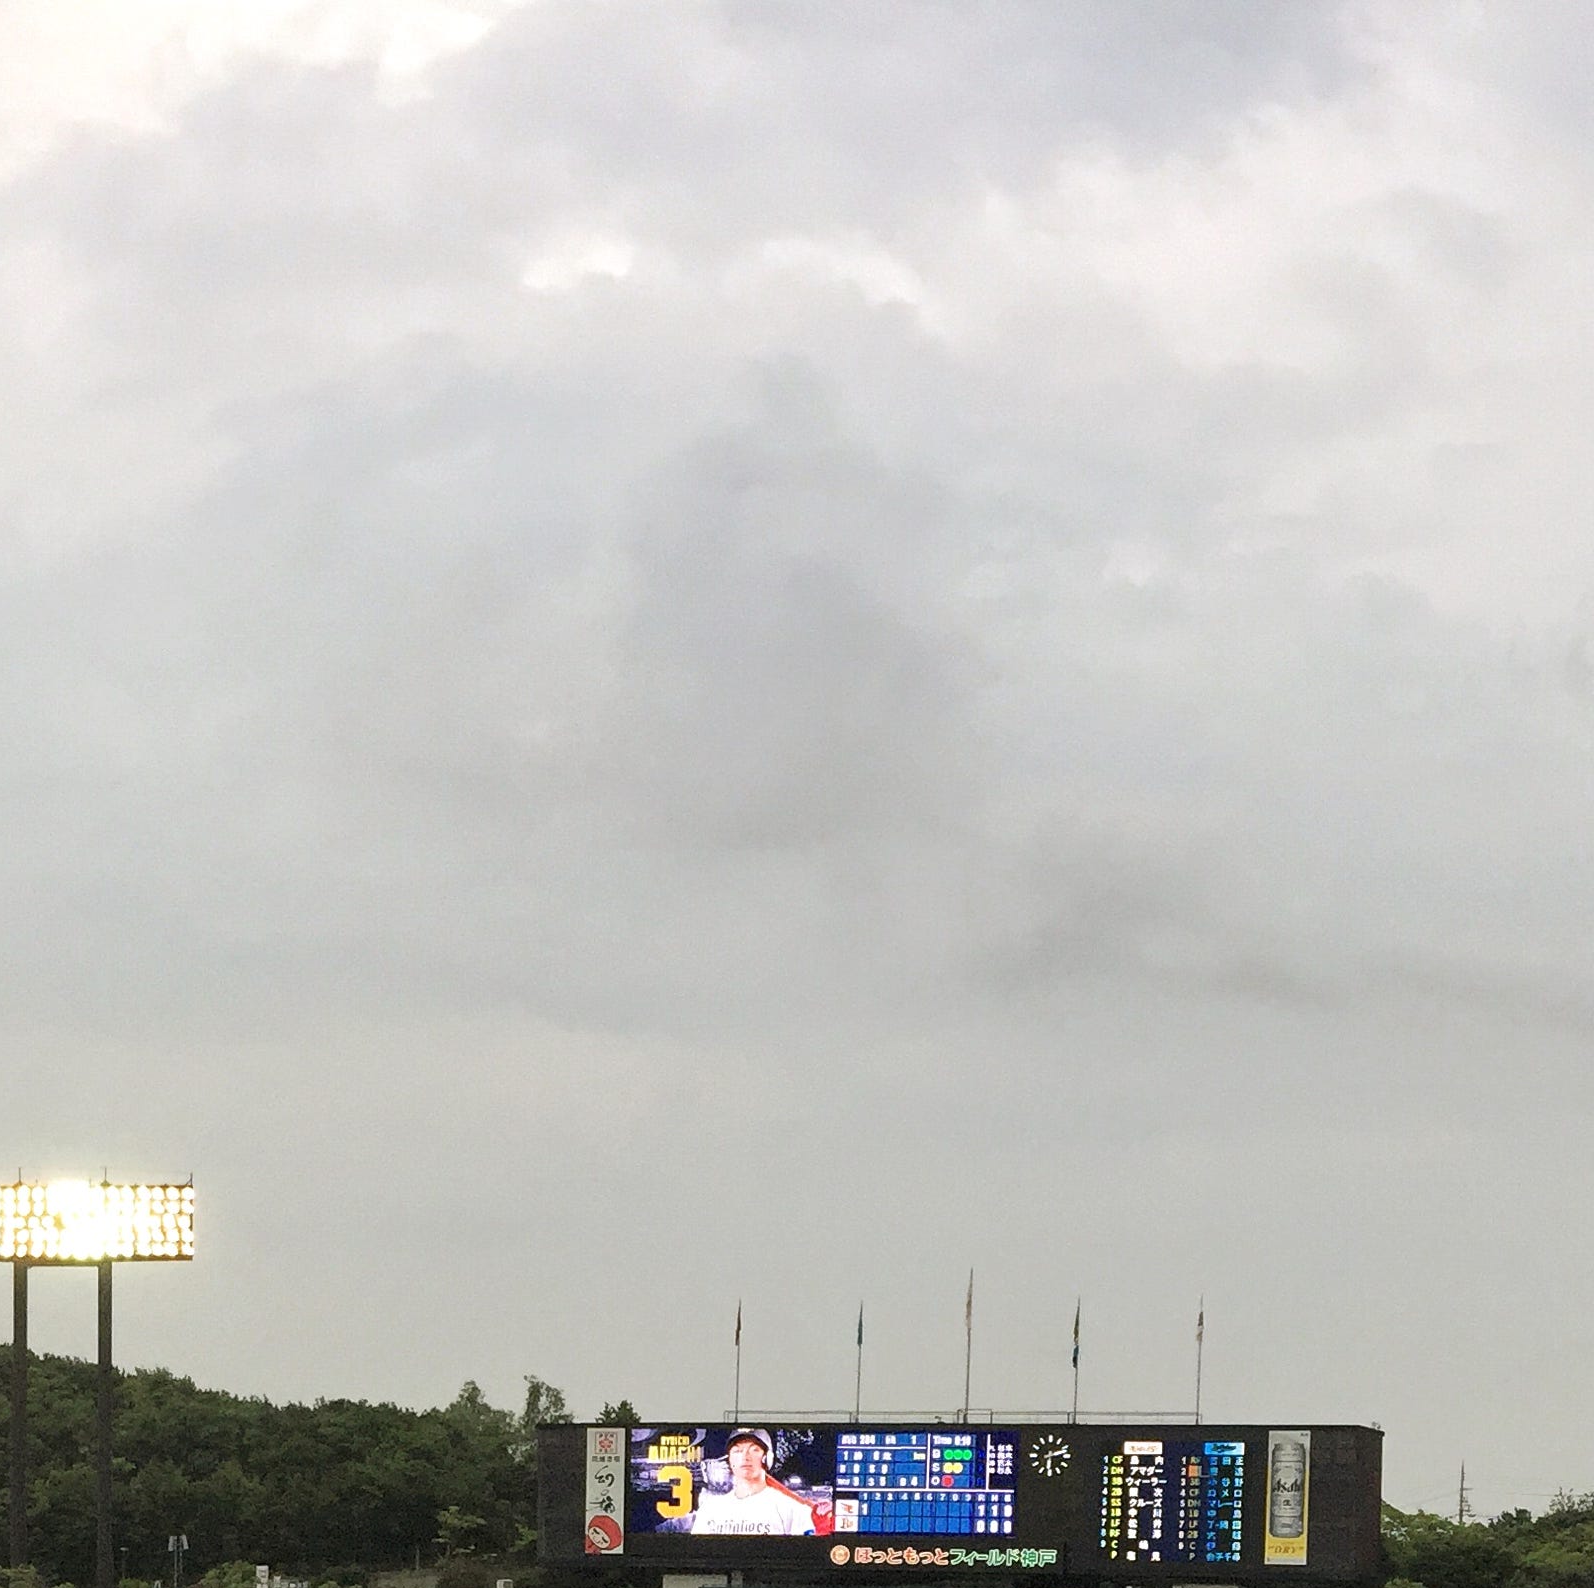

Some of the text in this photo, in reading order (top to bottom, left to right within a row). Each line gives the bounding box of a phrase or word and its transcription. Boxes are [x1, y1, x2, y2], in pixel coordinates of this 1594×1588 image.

[656, 1465, 692, 1519] 3
[861, 1502, 868, 1515] 1
[977, 1504, 985, 1517] 1
[991, 1504, 998, 1517] 1
[854, 1547, 1057, 1567] ほっともっとフィールド神戸
